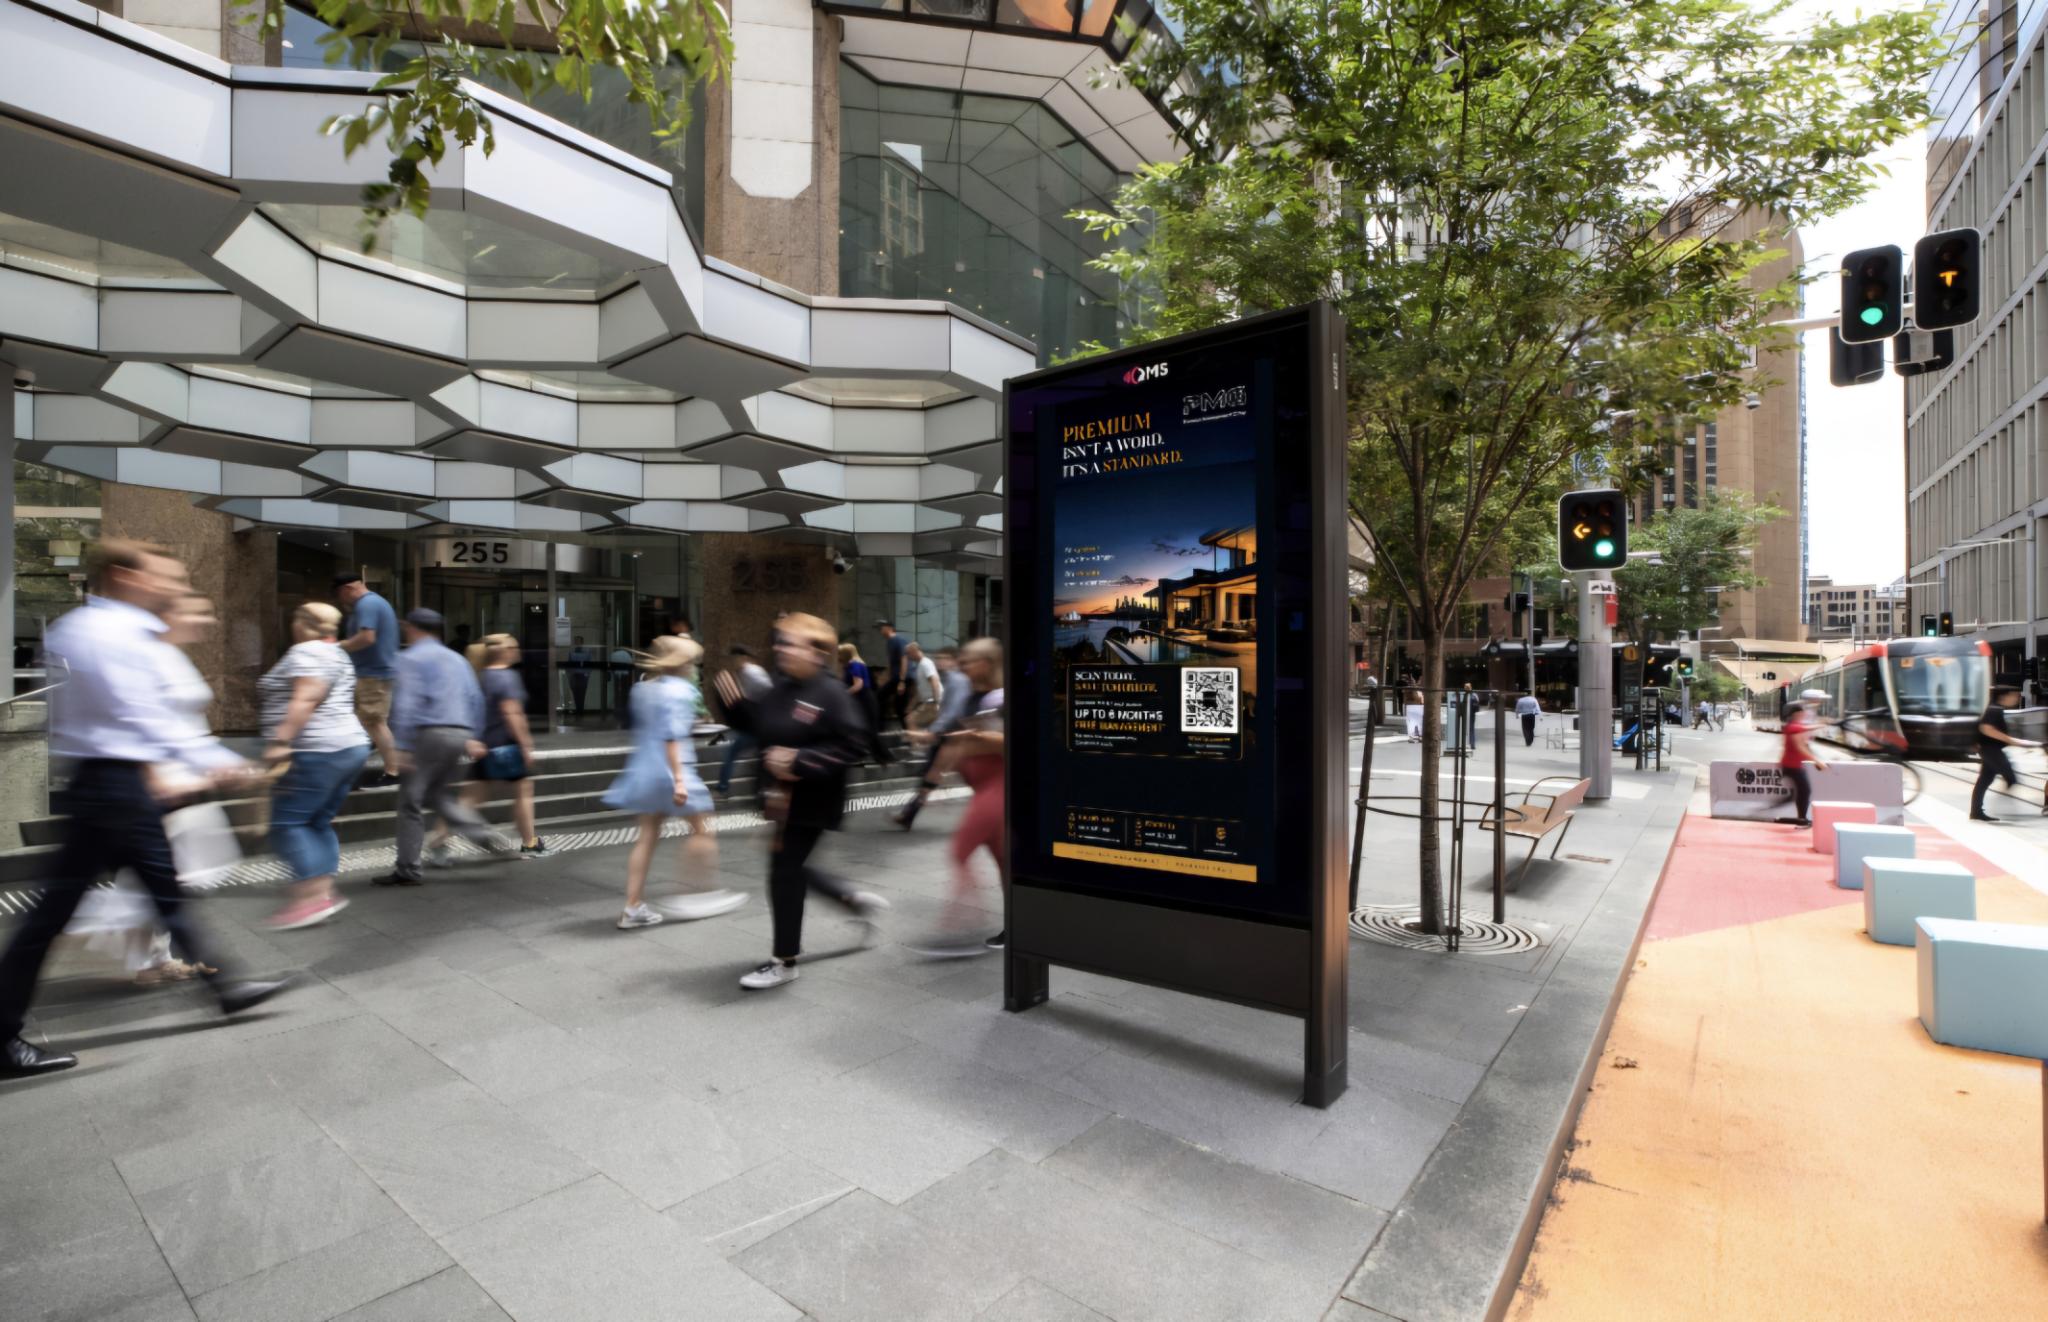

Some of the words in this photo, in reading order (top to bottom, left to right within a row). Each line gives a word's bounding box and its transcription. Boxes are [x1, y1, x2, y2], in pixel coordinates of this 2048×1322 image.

[1122, 362, 1170, 385] QMS
[1063, 411, 1151, 443] PREMIUM
[1103, 440, 1114, 454] A
[1116, 432, 1165, 452] WORD.
[1089, 462, 1101, 475] A
[1102, 450, 1184, 473] STANDARD.
[452, 541, 509, 564] 255
[1075, 708, 1090, 719] UP
[1092, 708, 1106, 719] TO
[1117, 710, 1164, 721] MONTHS
